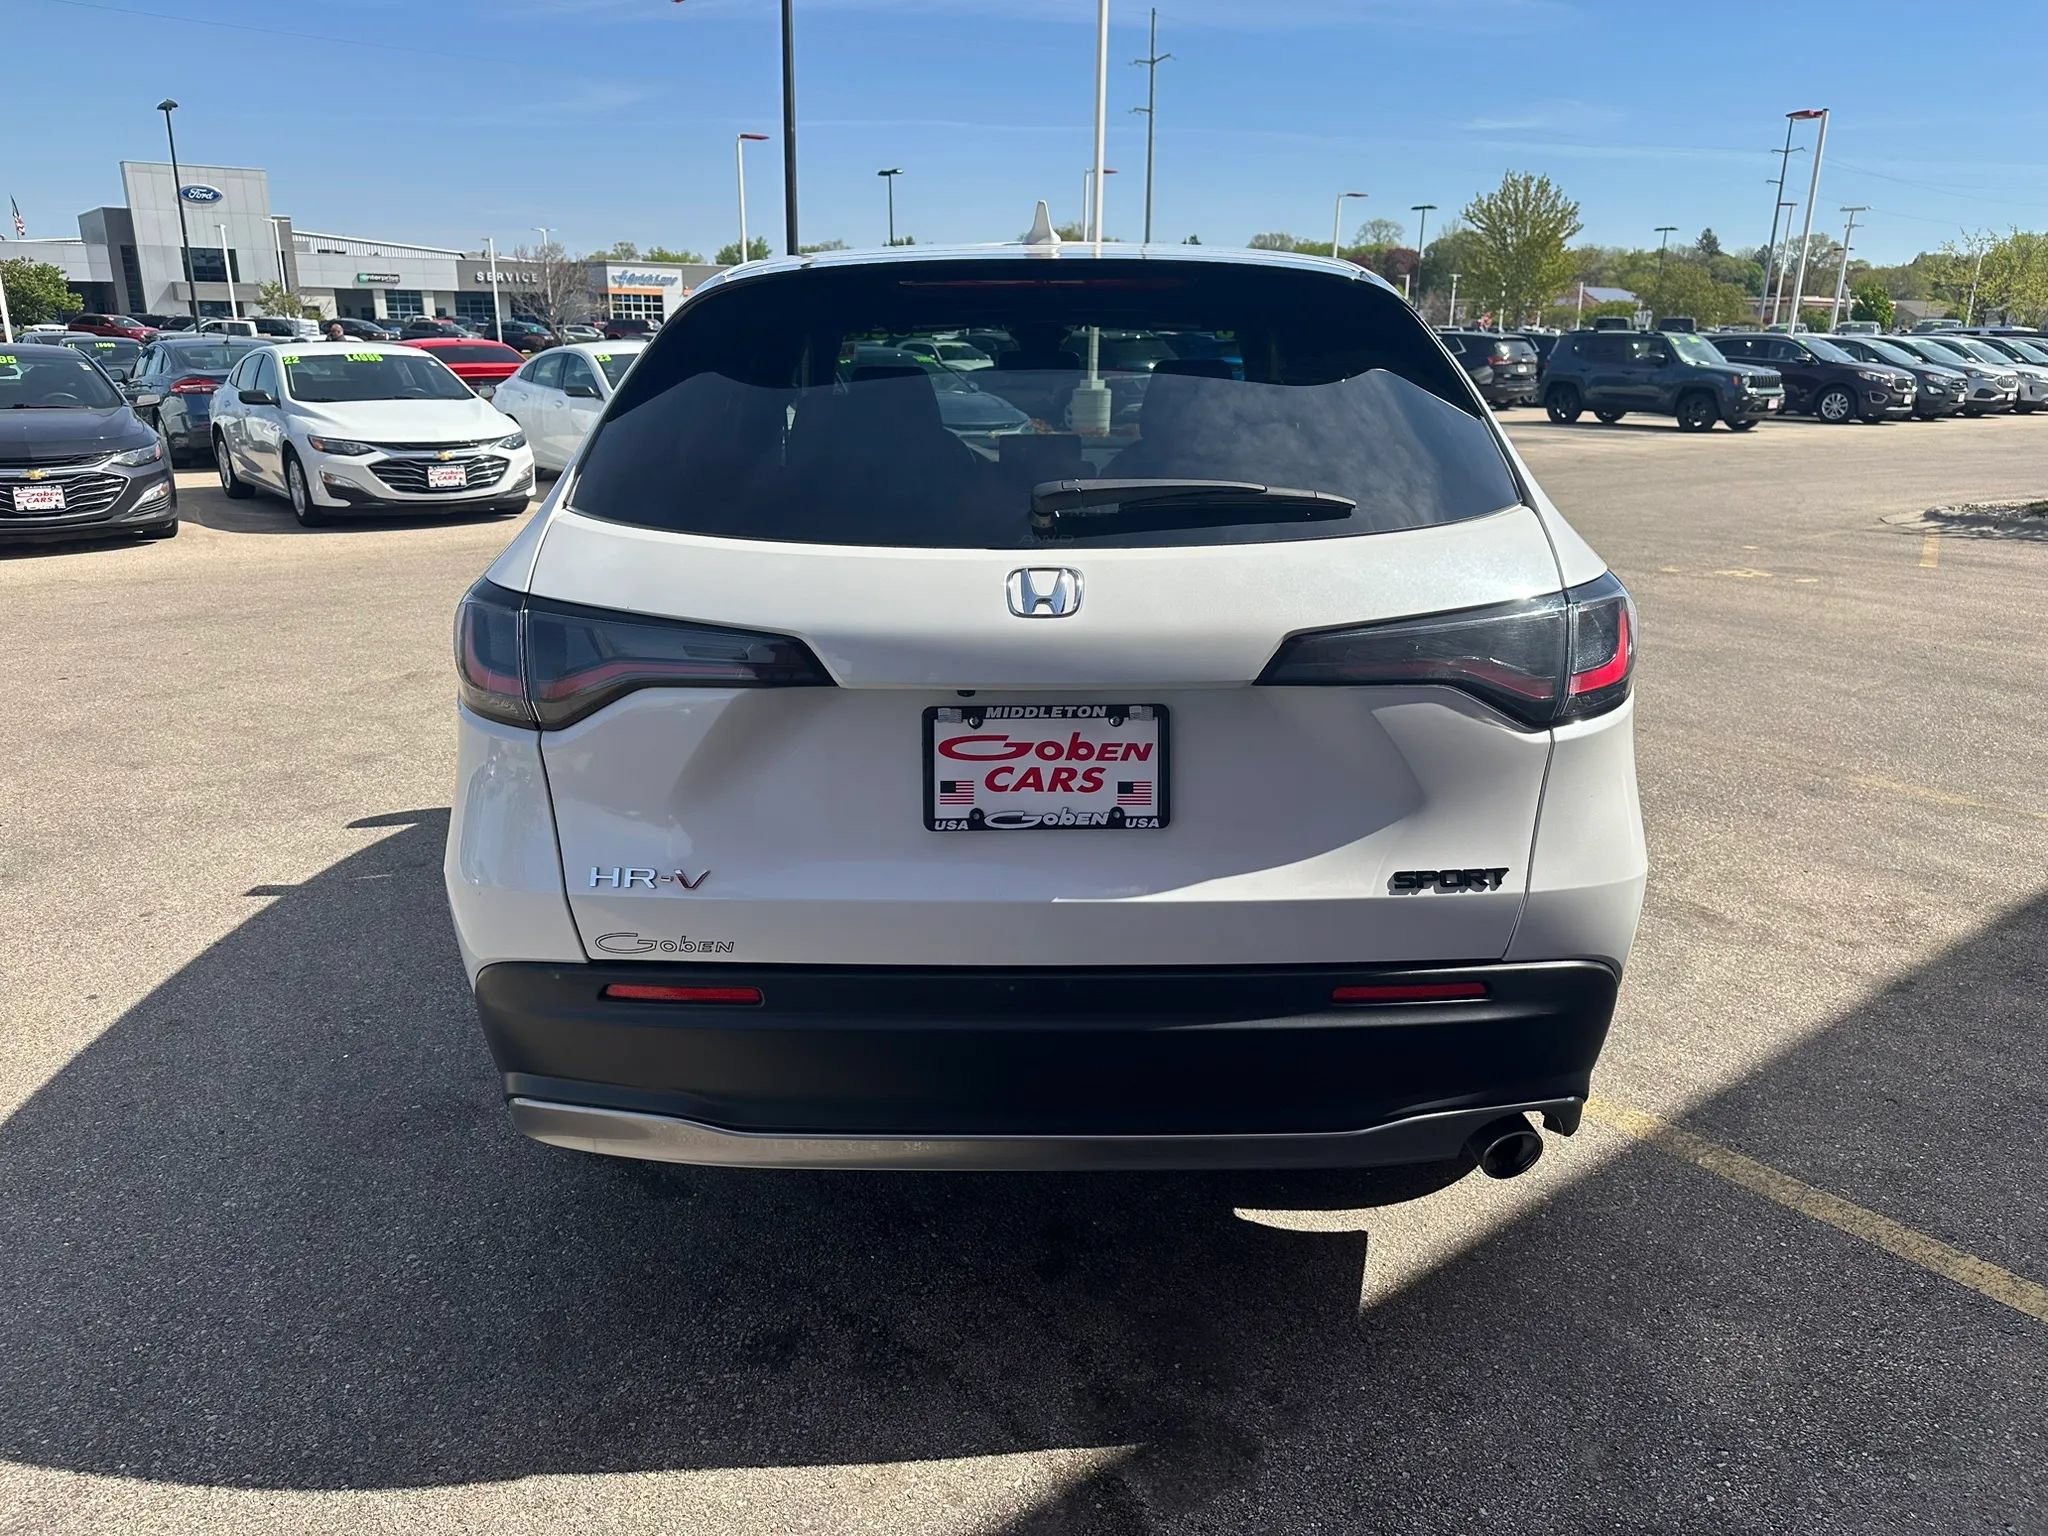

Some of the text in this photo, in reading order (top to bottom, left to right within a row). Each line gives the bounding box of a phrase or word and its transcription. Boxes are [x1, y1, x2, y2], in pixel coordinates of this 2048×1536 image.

[188, 187, 214, 200] Ford
[476, 271, 538, 283] SERVICE
[283, 356, 301, 365] 22
[26, 496, 53, 504] CARS
[985, 705, 1107, 719] MIDDLETON
[984, 766, 1107, 793] CARS
[934, 819, 969, 831] USA
[1125, 817, 1160, 829] USA
[589, 866, 711, 890] HR-V
[1392, 866, 1510, 890] SPORT
